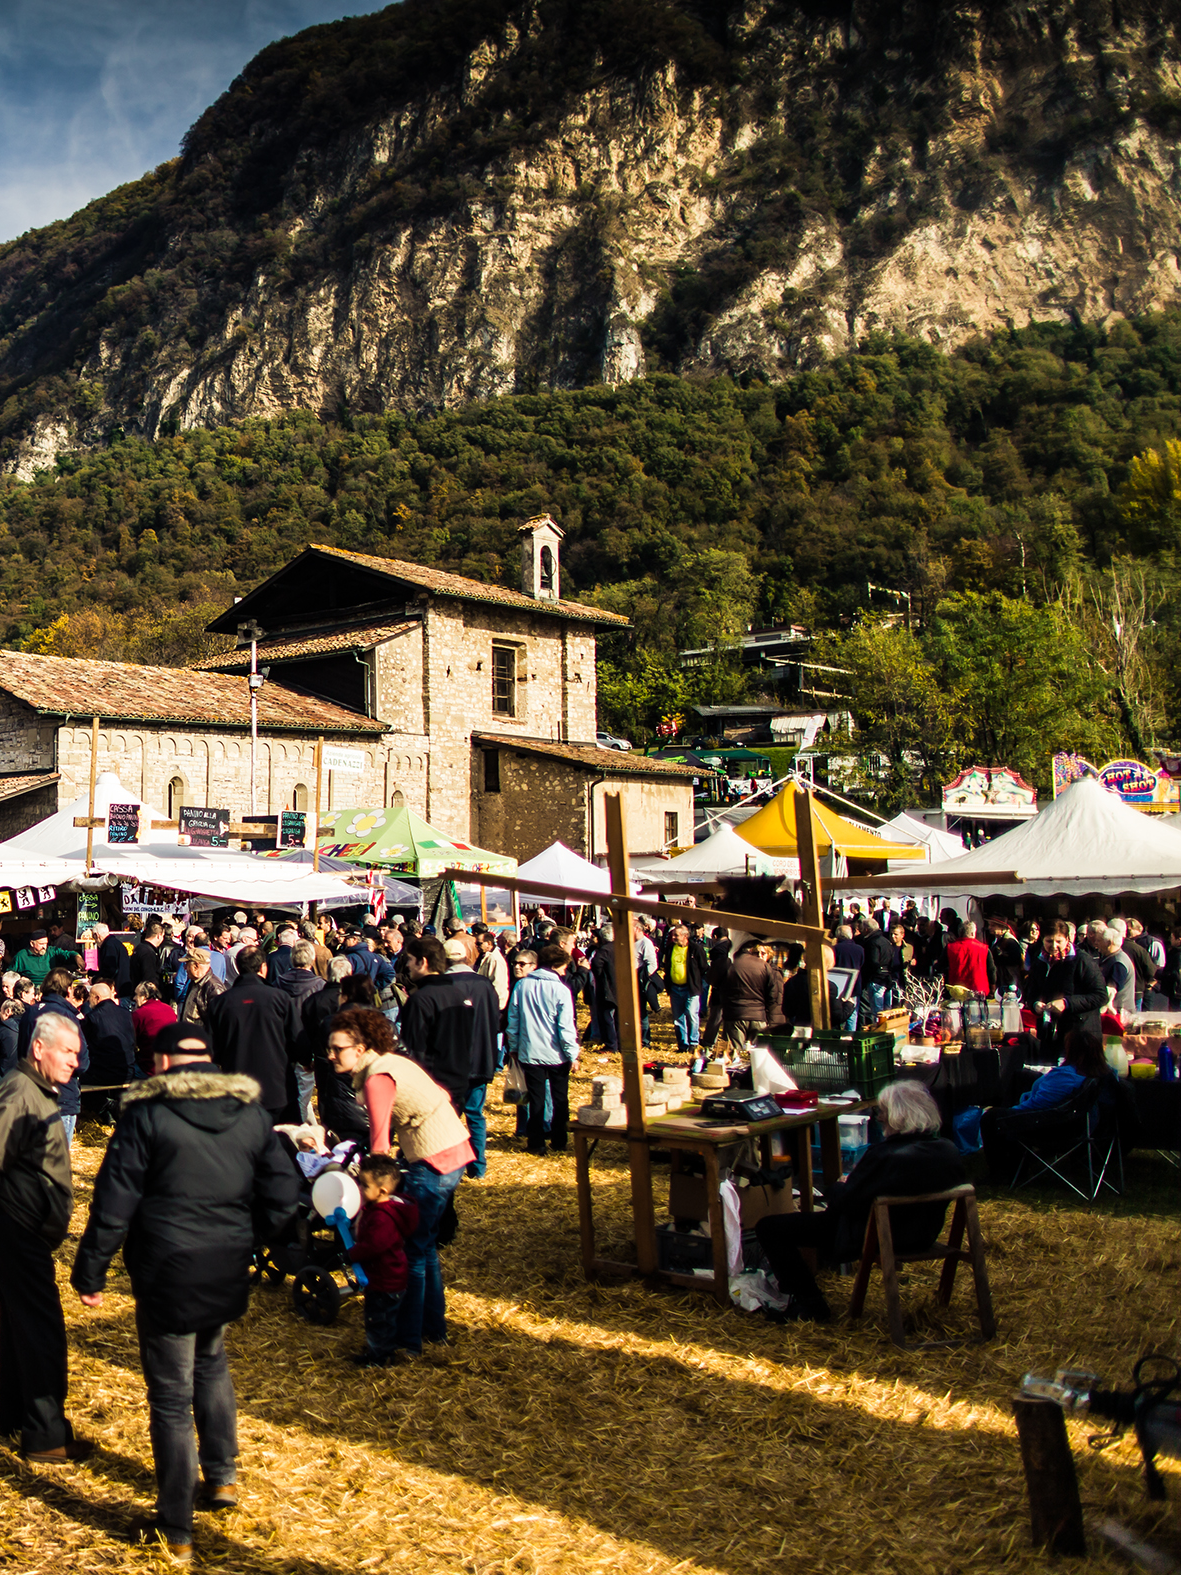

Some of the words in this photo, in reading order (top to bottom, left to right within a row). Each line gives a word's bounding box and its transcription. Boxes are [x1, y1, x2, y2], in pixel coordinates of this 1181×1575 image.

[323, 757, 363, 769] CADENAZZI
[1106, 769, 1131, 783] HOT
[1122, 779, 1155, 793] SHOT
[110, 804, 133, 813] CASSA
[203, 812, 217, 820] ALLA
[78, 894, 99, 902] CASSA
[78, 911, 100, 922] PANINO
